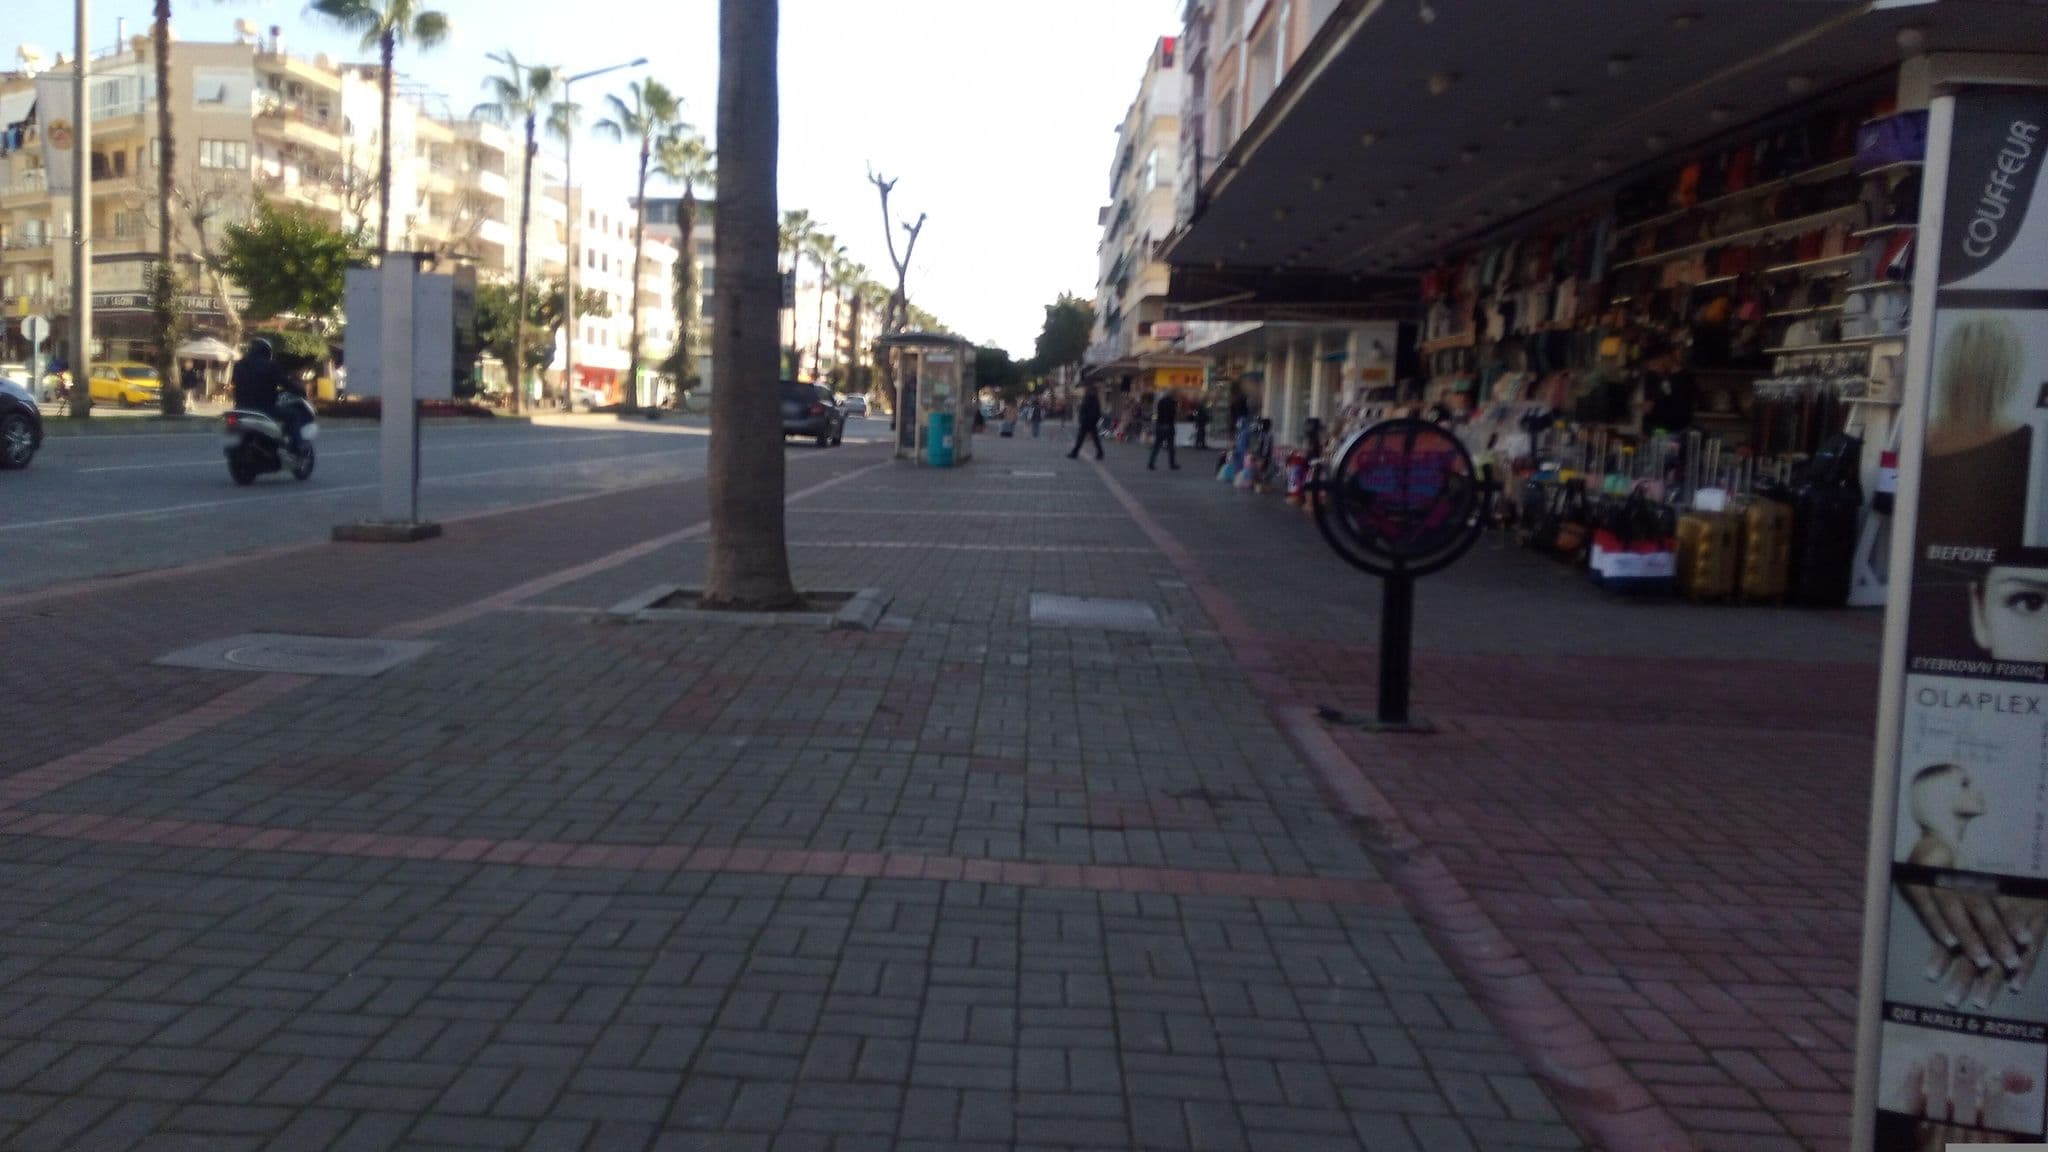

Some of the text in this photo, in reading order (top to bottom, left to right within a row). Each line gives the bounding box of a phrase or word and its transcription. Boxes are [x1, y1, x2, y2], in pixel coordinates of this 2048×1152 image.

[1962, 119, 2040, 258] COUFFEUR
[1926, 545, 1998, 562] BEFORE
[1911, 656, 2045, 680] EYEBROW FIXING
[1917, 687, 2041, 714] OLAPLEX
